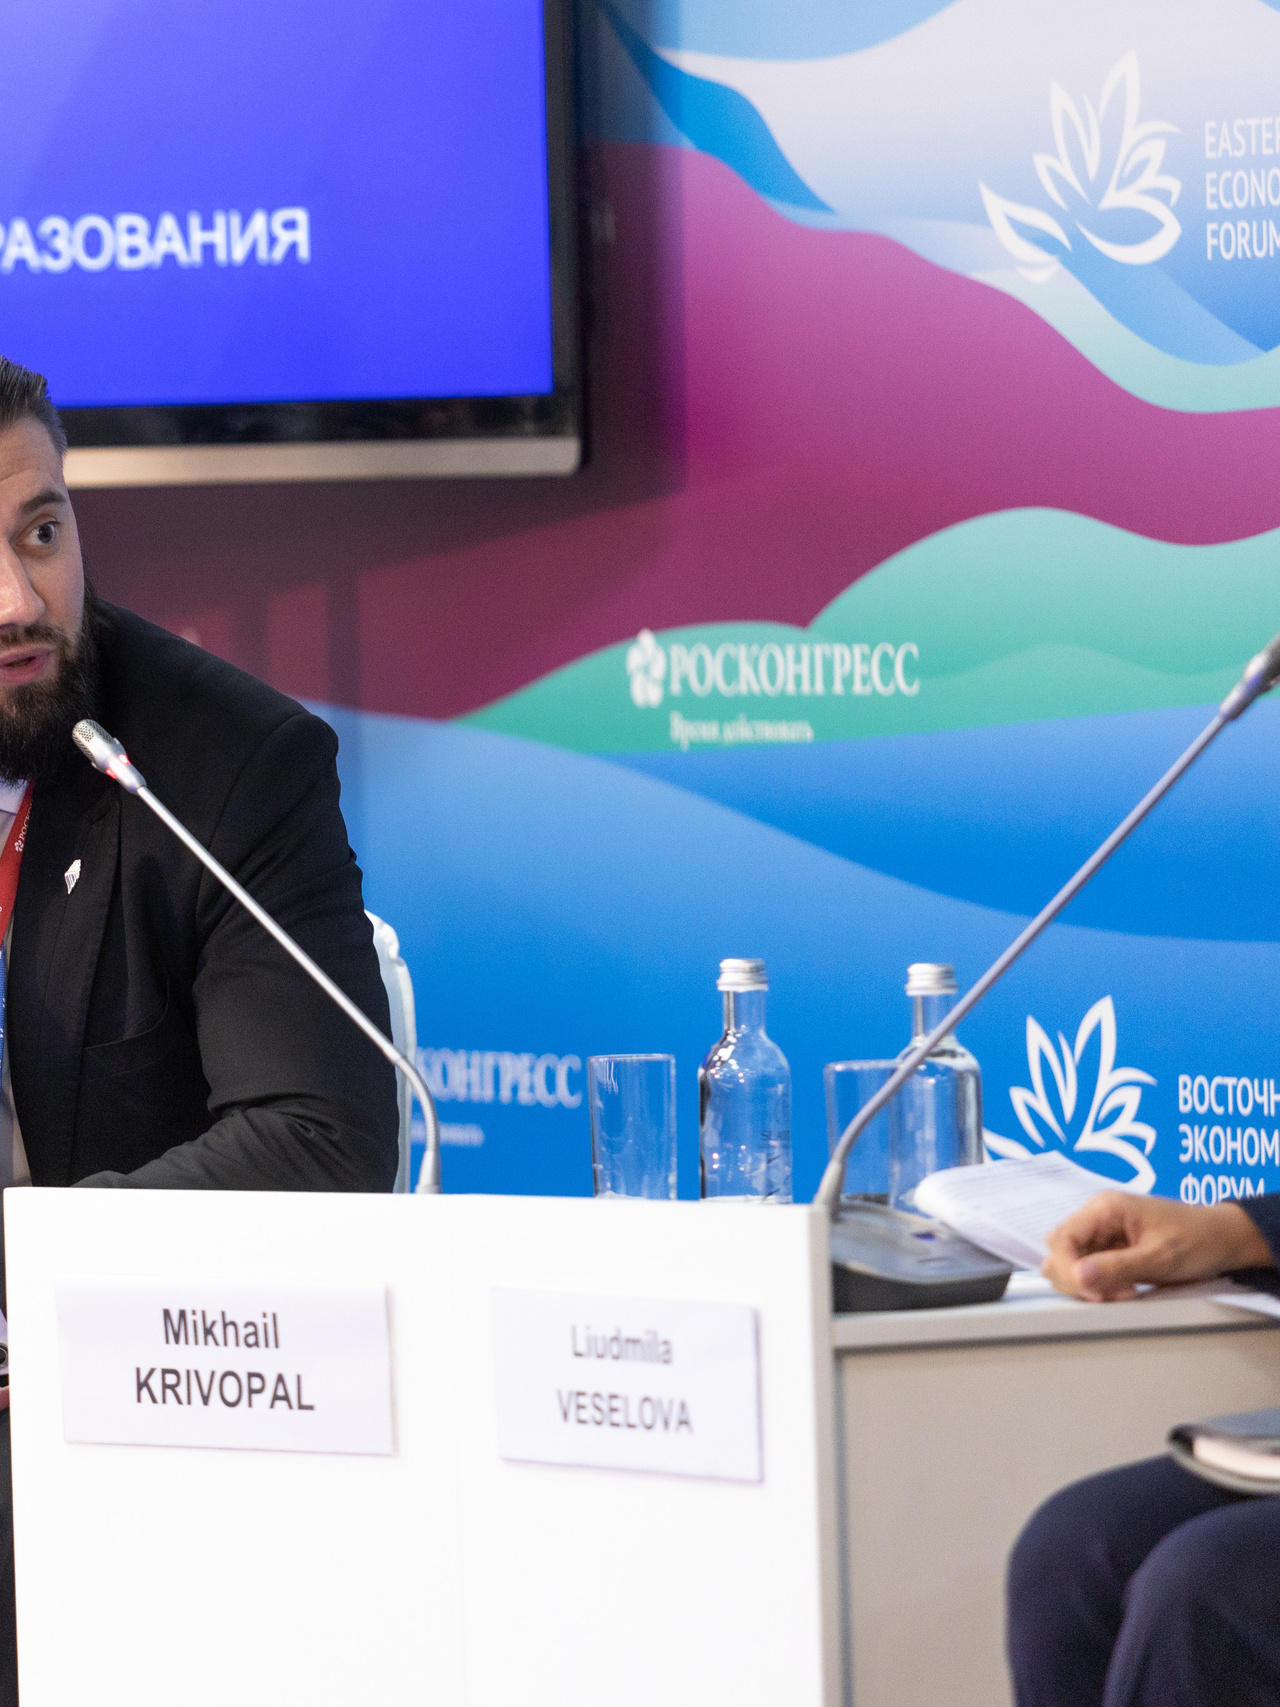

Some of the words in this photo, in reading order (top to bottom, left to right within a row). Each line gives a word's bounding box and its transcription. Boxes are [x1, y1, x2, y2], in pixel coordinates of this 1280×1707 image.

[669, 642, 920, 697] РОСКОНГРЕСС
[162, 1308, 280, 1349] Mikhail
[136, 1367, 315, 1411] KRIVOPAL
[556, 1388, 695, 1433] VESELOVA
